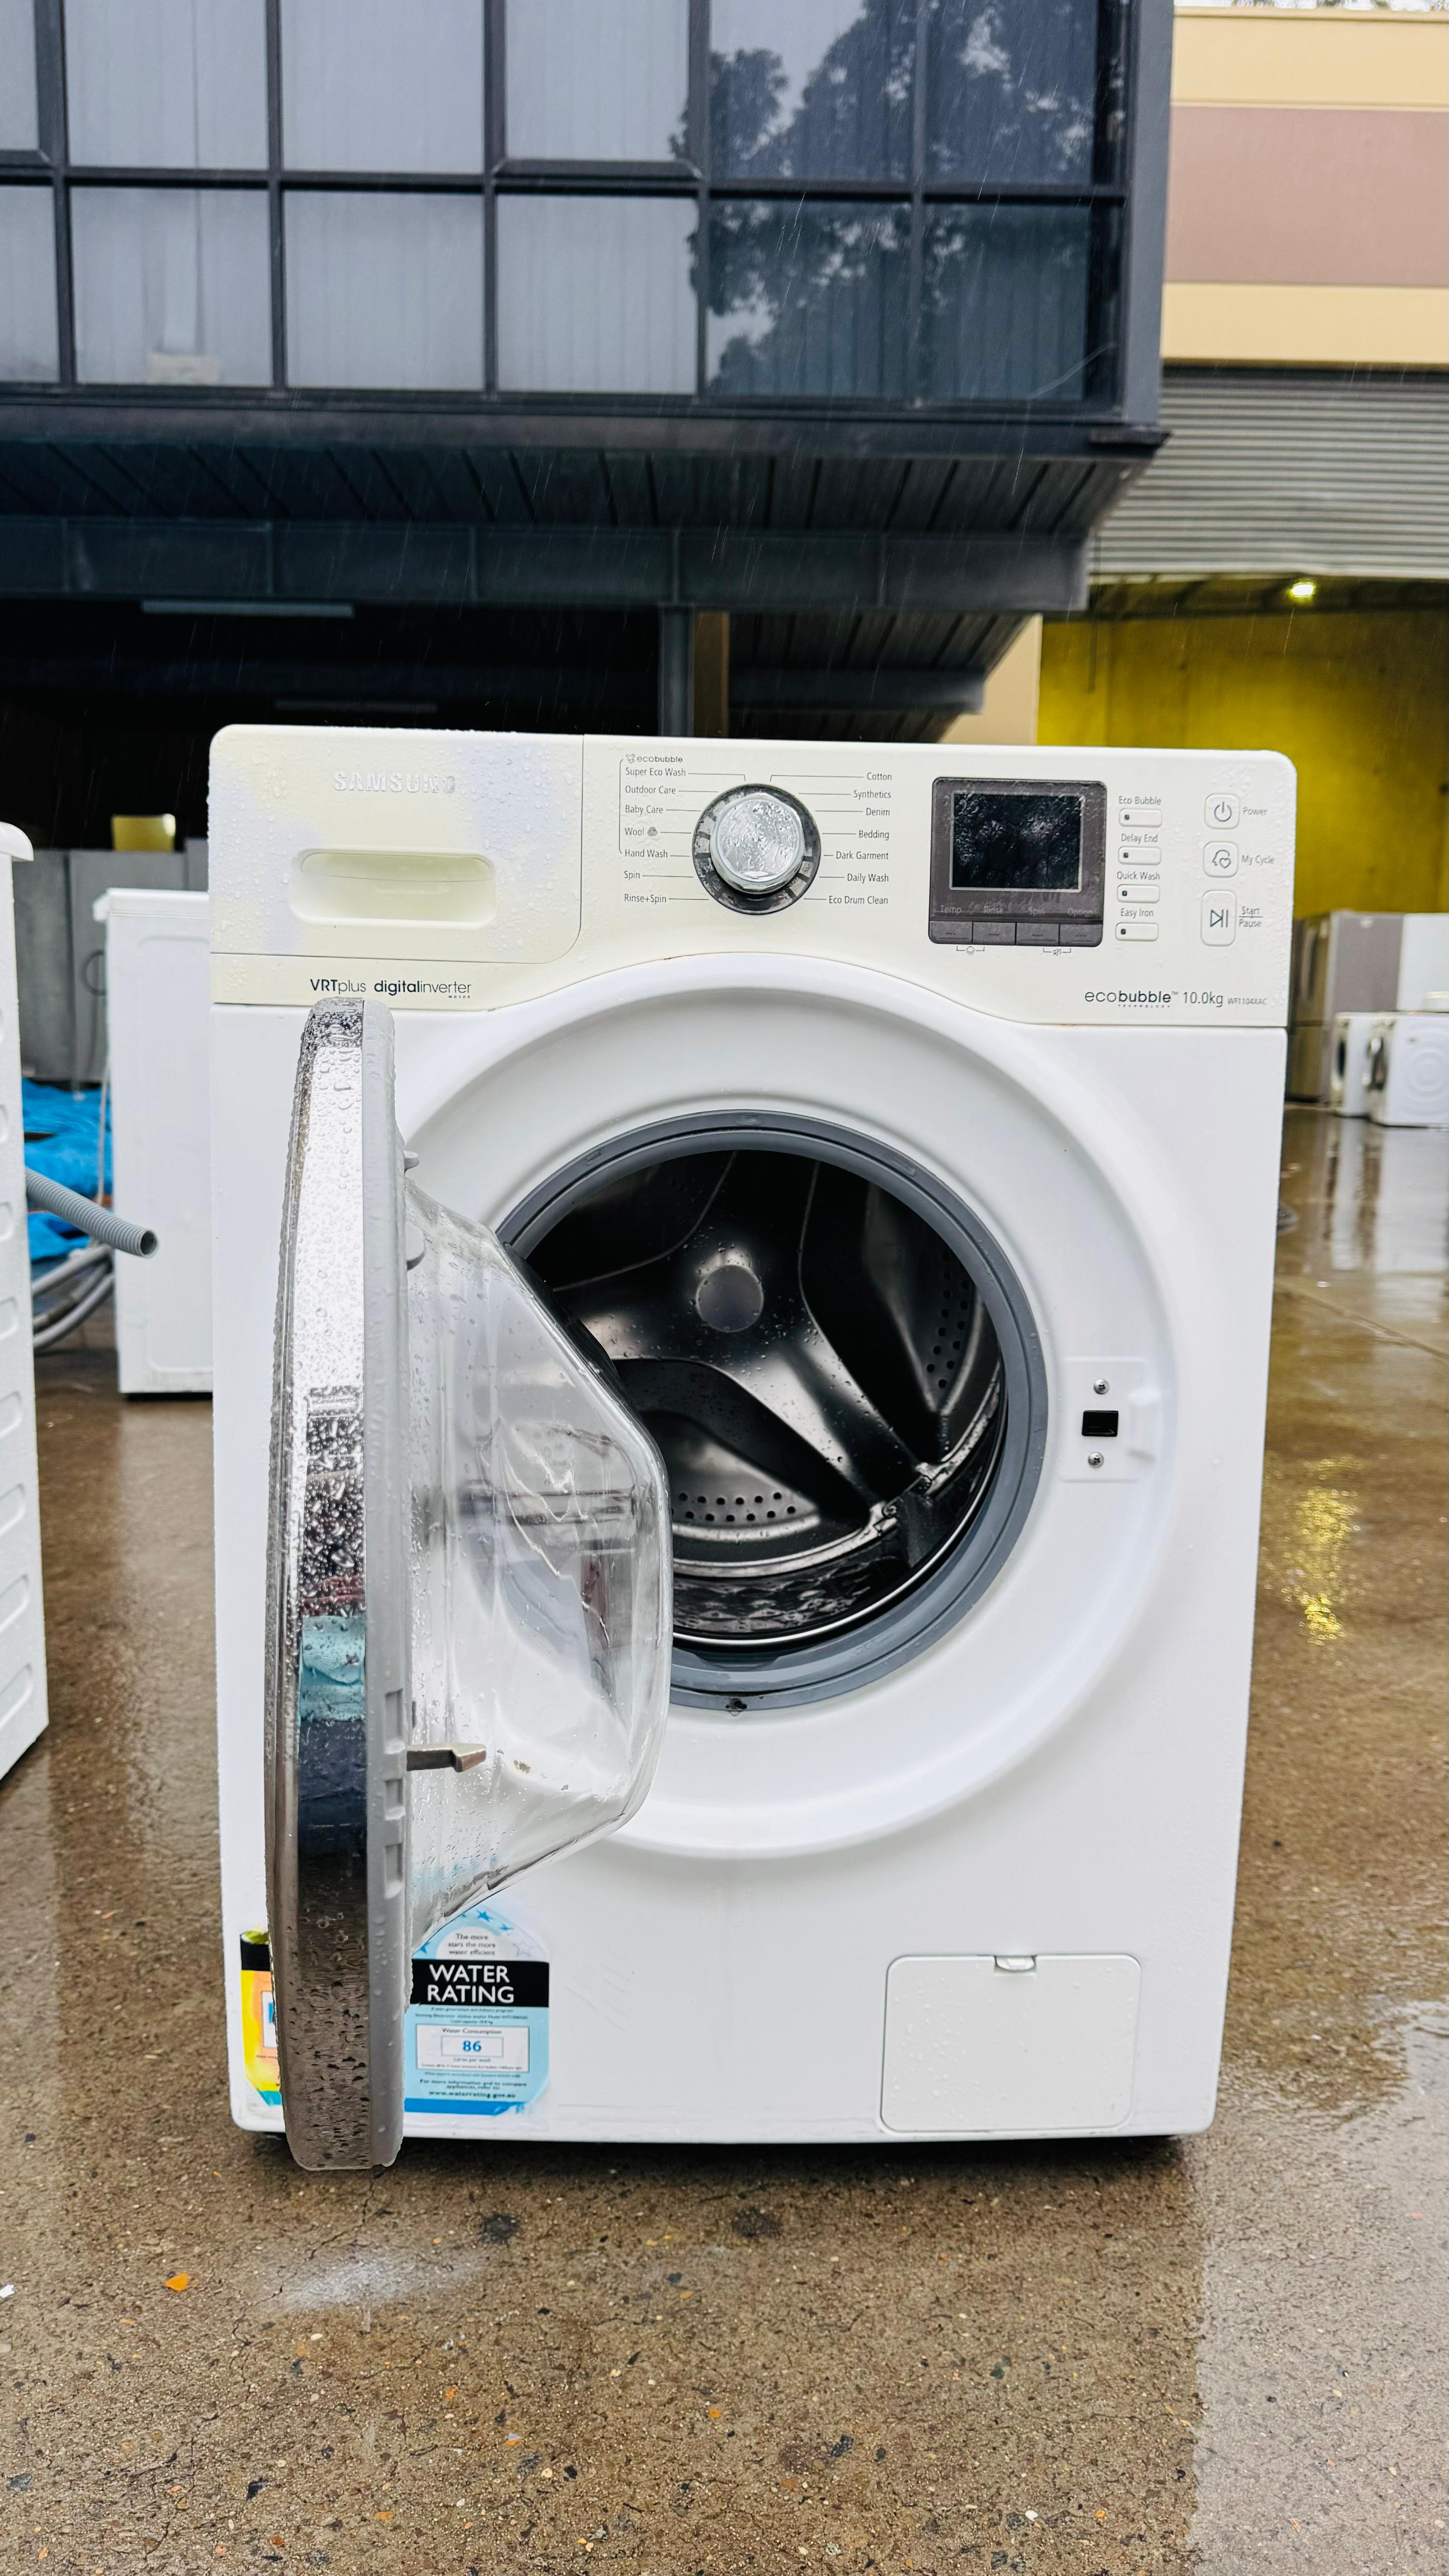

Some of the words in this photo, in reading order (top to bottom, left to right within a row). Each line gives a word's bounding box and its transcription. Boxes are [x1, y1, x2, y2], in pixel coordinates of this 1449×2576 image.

[625, 767, 647, 777] Super
[650, 767, 663, 776] Eco
[665, 768, 686, 776] Wash
[867, 772, 892, 780] Cotton
[334, 771, 455, 793] SAMSUNG
[625, 785, 656, 793] Outdoor
[659, 786, 676, 794] Care
[853, 789, 892, 800] Synthetics
[1118, 796, 1132, 804] Eco
[1135, 796, 1161, 805] Bubble
[625, 804, 643, 816] Baby
[646, 805, 663, 814] Care
[866, 807, 890, 816] Denim
[1243, 807, 1267, 815] Power
[625, 827, 645, 836] Wool
[859, 830, 890, 841] Bedding
[1121, 833, 1142, 844] Delay
[1144, 834, 1158, 842] End
[625, 849, 645, 857] Hand
[647, 849, 668, 858] Wash
[836, 850, 854, 859] Dark
[856, 851, 889, 860] Garment
[1241, 855, 1253, 865] My
[1255, 855, 1274, 865] Cycle
[624, 870, 640, 880] Spin
[847, 873, 866, 884] Daily
[868, 873, 889, 882] Wash
[1117, 871, 1137, 880] Quick
[1140, 871, 1161, 880] Wash
[624, 894, 667, 905] Rinse+Spin
[829, 896, 842, 904] Eco
[844, 896, 865, 904] Drum
[867, 896, 888, 904] Clean
[939, 905, 961, 915] Temp
[984, 906, 1004, 914] Rinse
[1028, 907, 1045, 916] Spin
[1067, 907, 1093, 916] Option
[1120, 908, 1137, 919] Easy
[1139, 909, 1154, 917] Iron
[1241, 906, 1260, 915] Start
[1239, 919, 1261, 927] Pause
[310, 979, 366, 994] VRTplus
[374, 980, 471, 996] digitalinverter
[1183, 991, 1224, 1007] 10.0kg
[429, 1964, 510, 1983] WATER
[428, 1984, 514, 2003] RATING
[462, 2041, 482, 2052] 86
